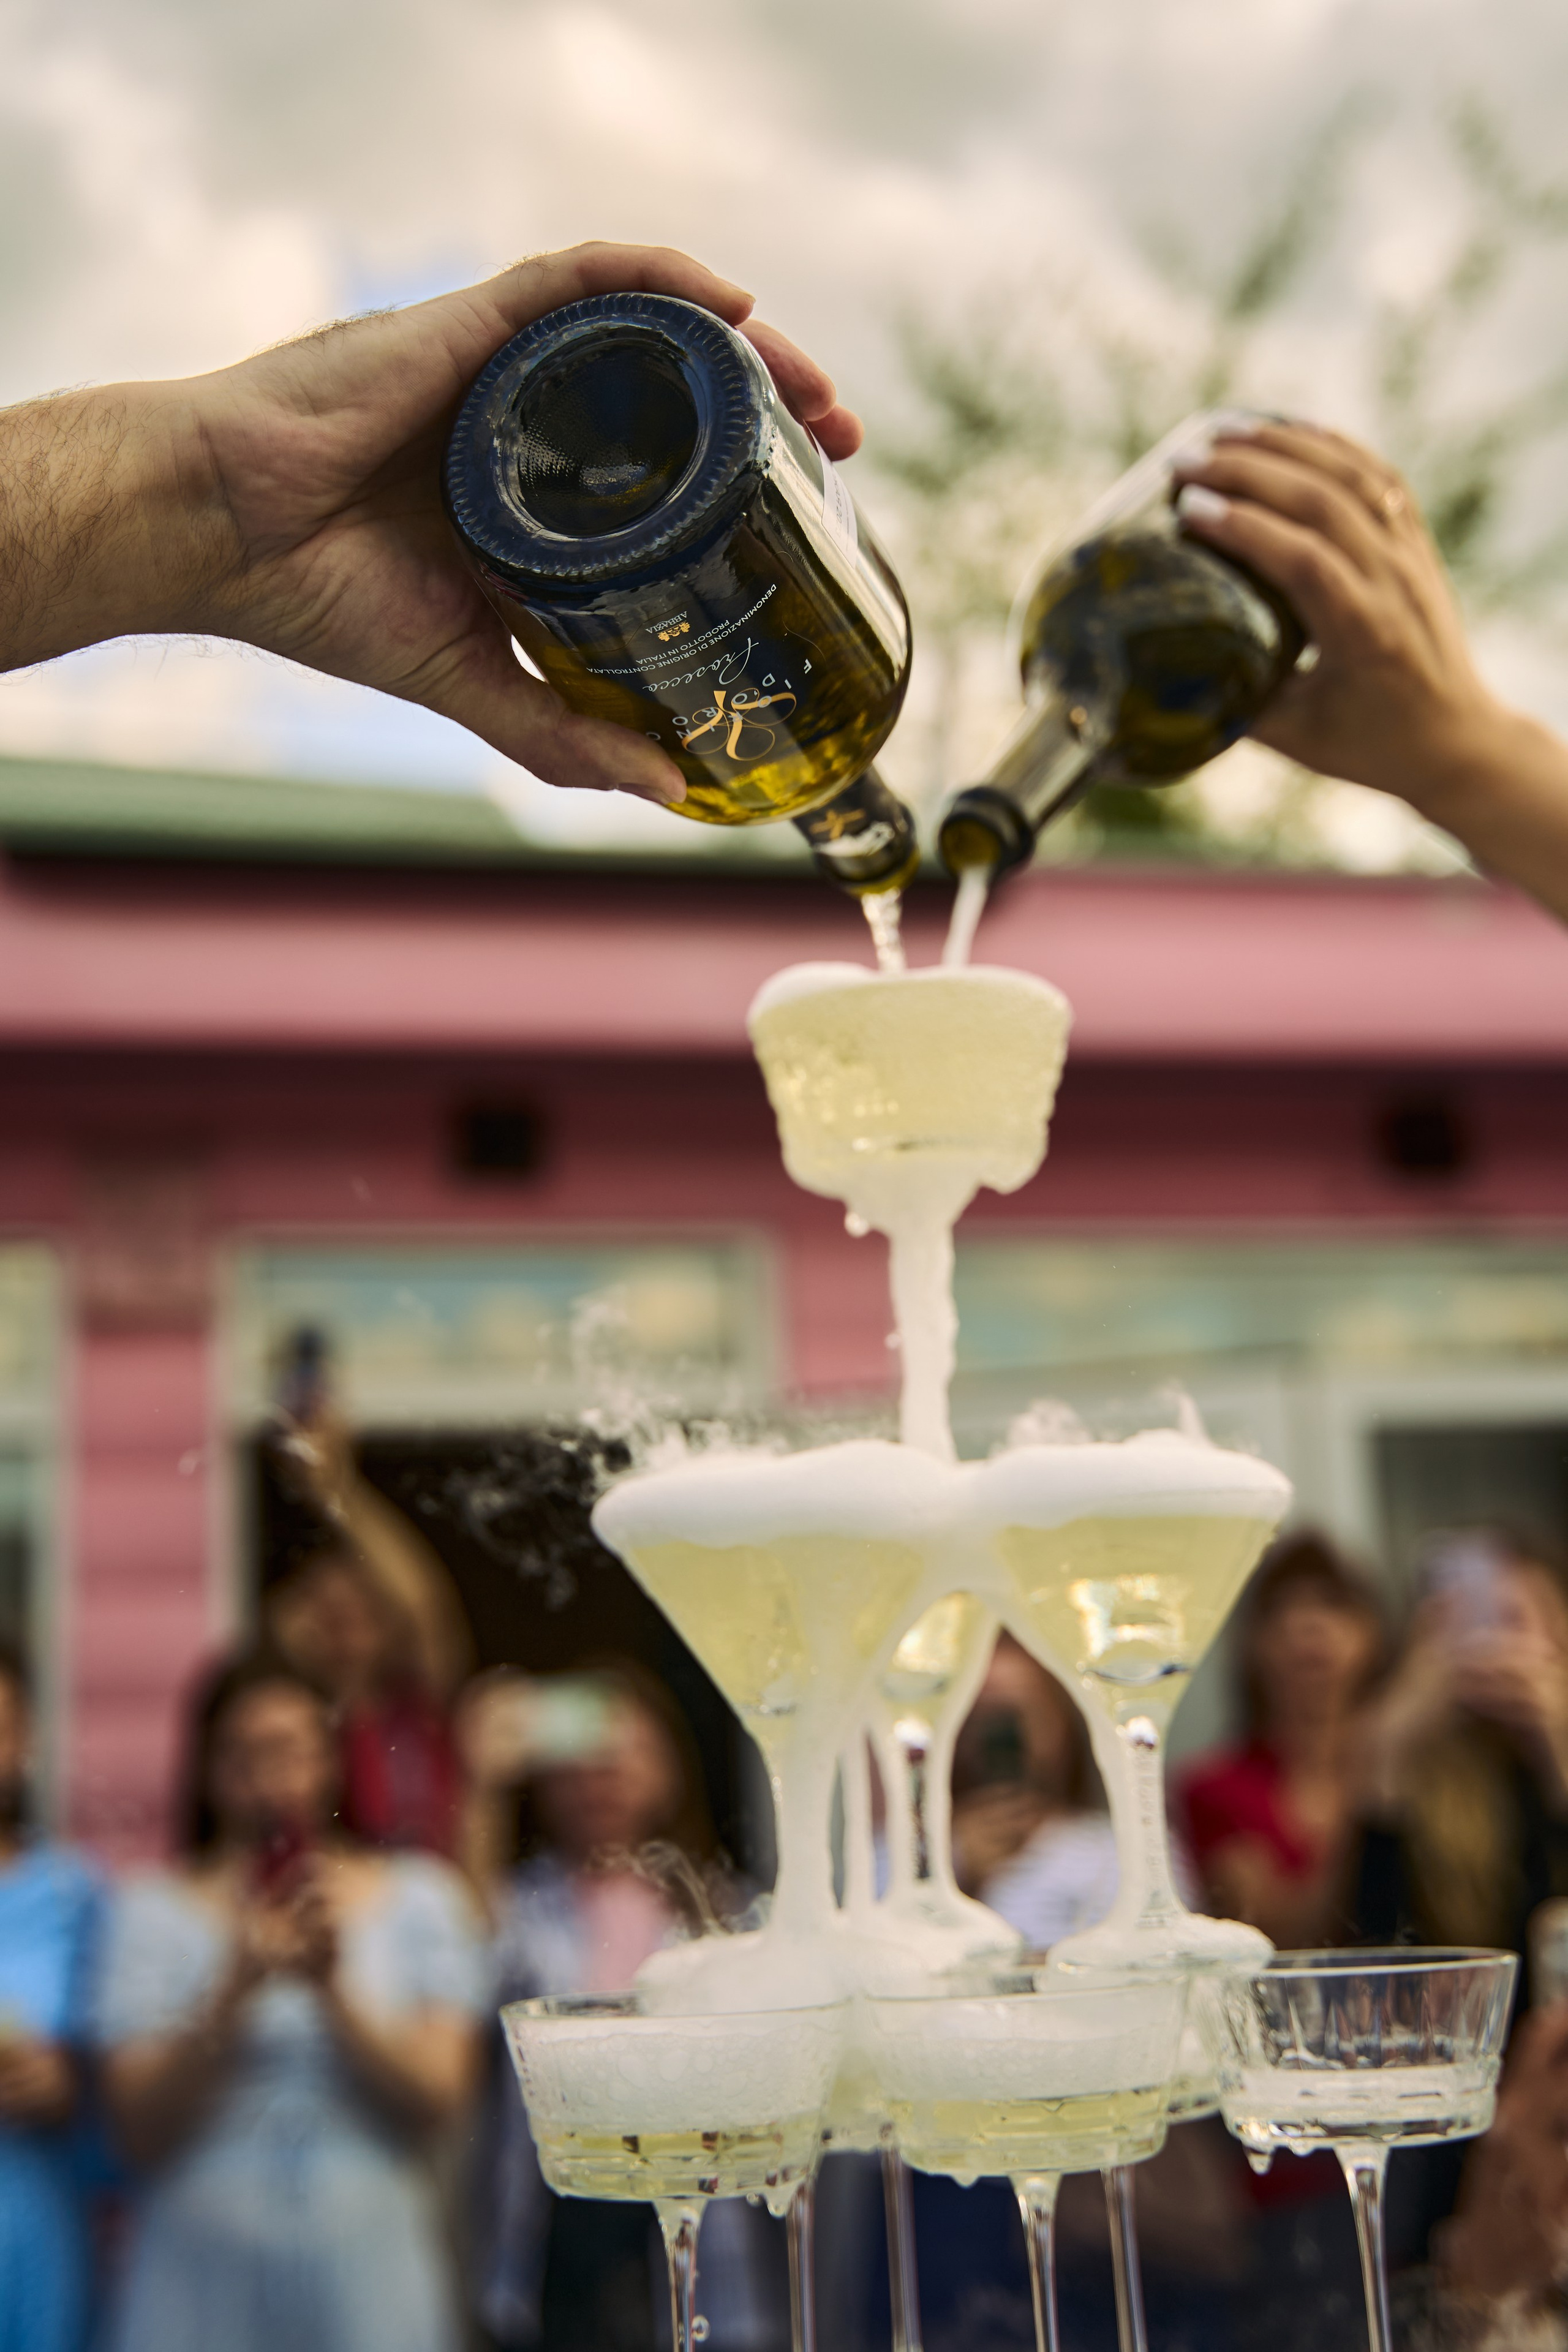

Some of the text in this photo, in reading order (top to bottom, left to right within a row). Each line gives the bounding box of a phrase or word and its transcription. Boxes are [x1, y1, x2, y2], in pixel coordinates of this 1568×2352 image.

[645, 611, 687, 634] ABBAZIA
[709, 584, 777, 646] DENOMINAZIONE
[635, 619, 730, 665] PRODOTTO IN ITALIA
[658, 649, 697, 668] ORIGINE
[586, 665, 656, 674] CONTROLLATA
[642, 637, 760, 692] Prosecco
